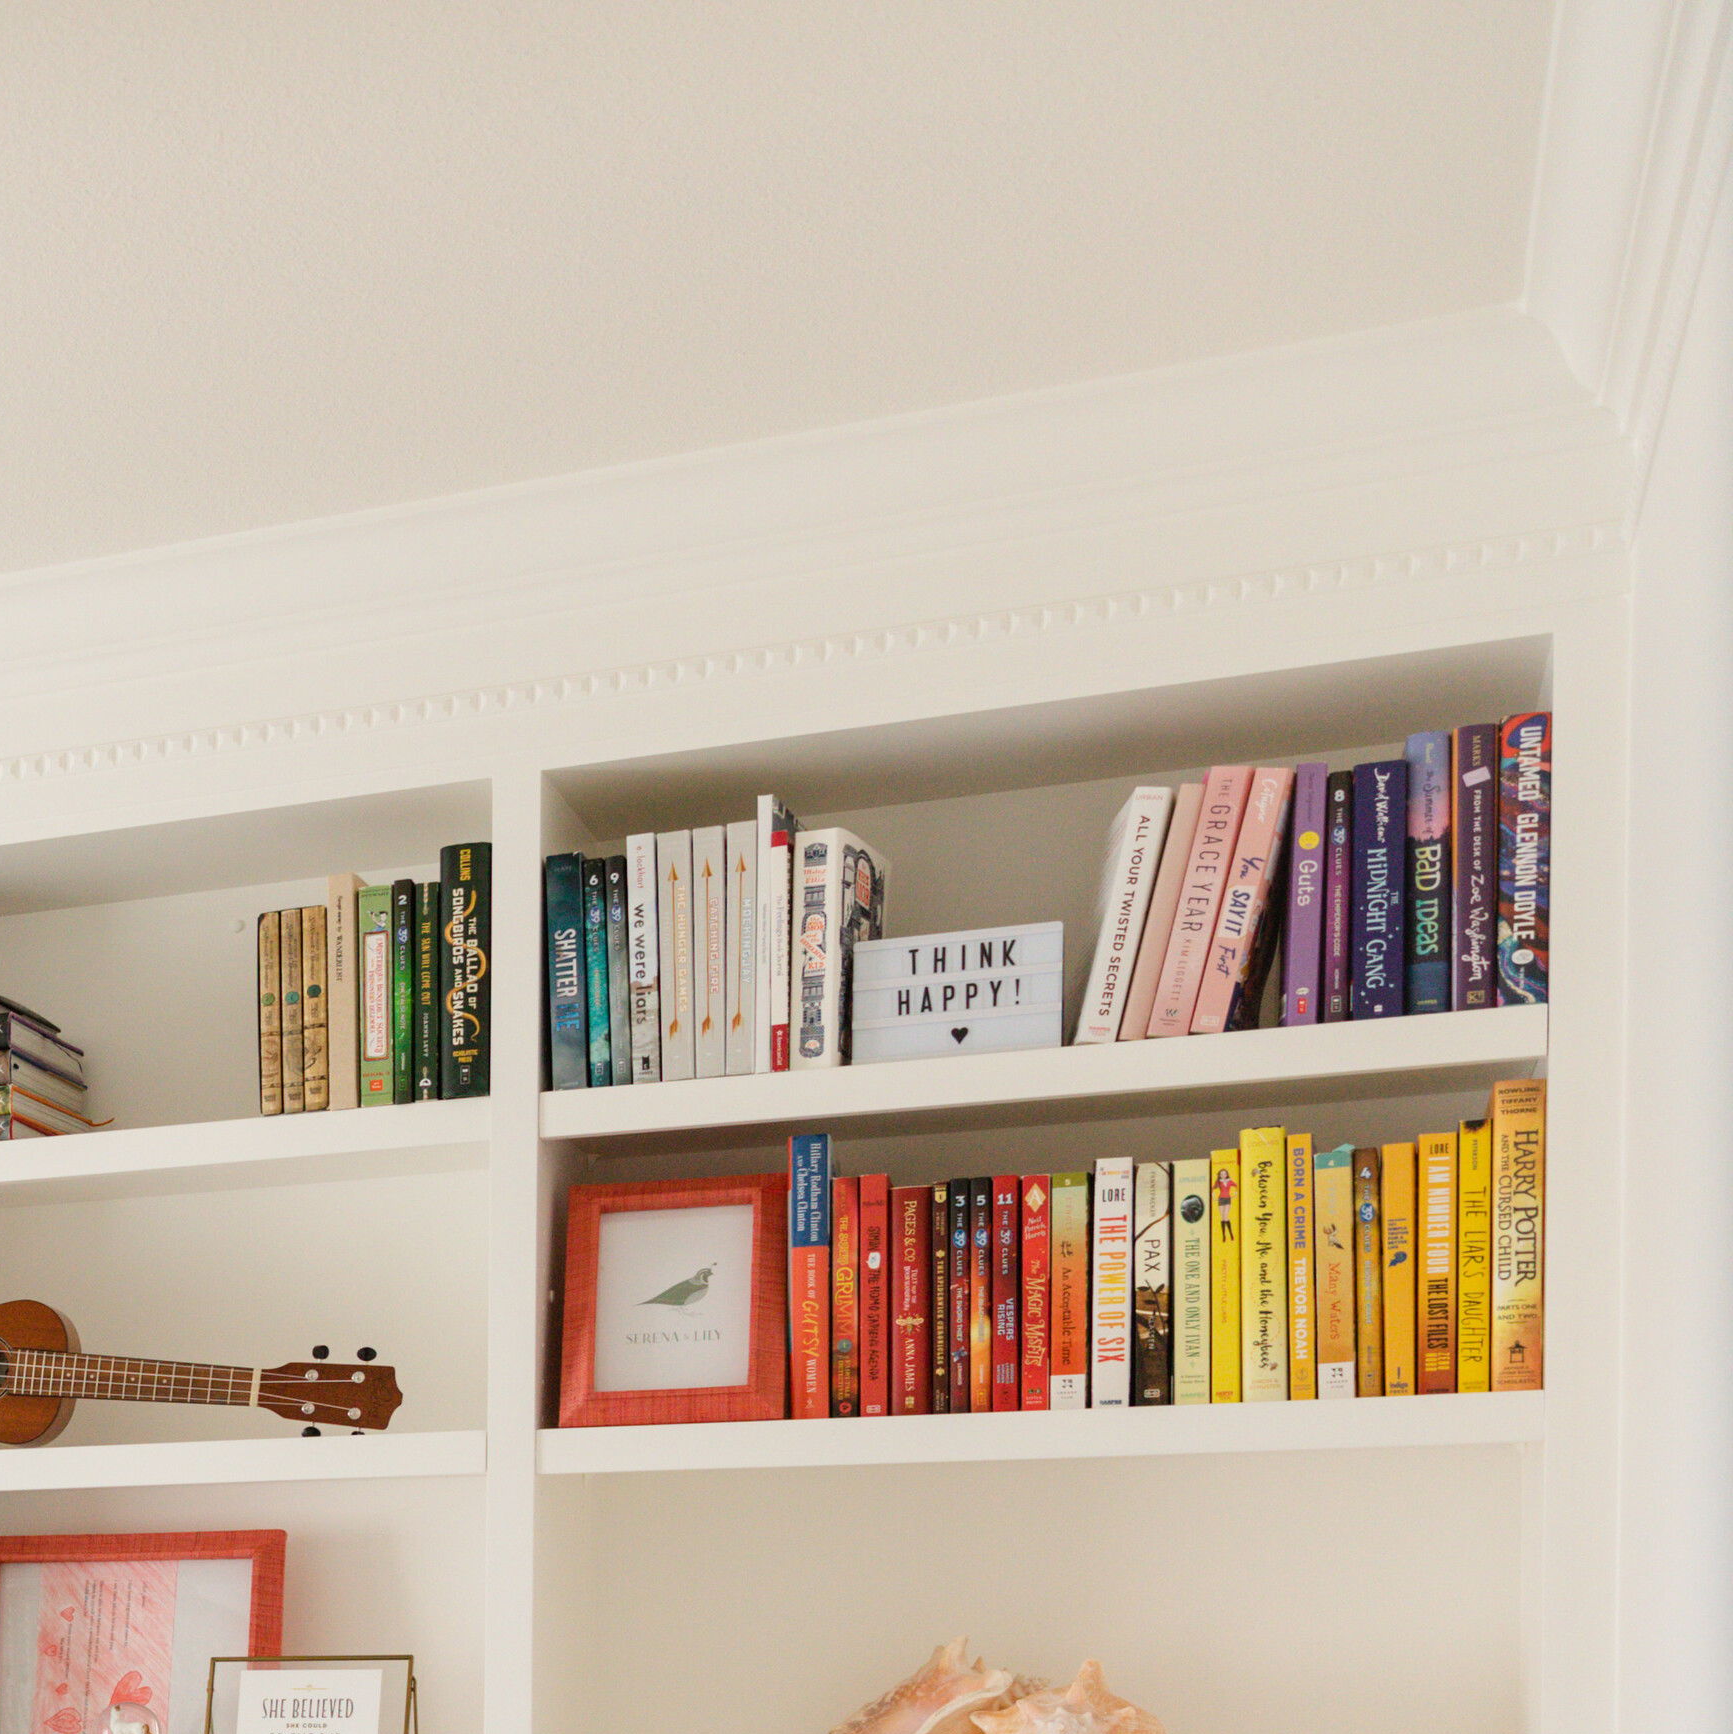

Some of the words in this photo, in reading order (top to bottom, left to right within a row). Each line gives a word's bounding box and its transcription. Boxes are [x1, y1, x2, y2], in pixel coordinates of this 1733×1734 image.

[1517, 726, 1542, 801] UNTAMED
[1218, 779, 1233, 797] THE
[1473, 790, 1482, 813] FROM
[1135, 815, 1151, 842] ALL
[1195, 804, 1231, 874] GRACE
[1473, 817, 1481, 832] THE
[1473, 836, 1481, 858] DESK
[1514, 813, 1539, 886] GLENNON
[459, 849, 472, 881] COLLINS
[1126, 847, 1145, 885] YOUR
[1473, 861, 1481, 871] OF
[1297, 859, 1318, 907] Guts
[398, 895, 408, 905] 2
[634, 903, 646, 929] we
[1180, 882, 1213, 932] YEAR
[1229, 890, 1251, 918] SAY
[1513, 891, 1535, 940] DOYLE
[452, 887, 464, 965] SONGBIRDS
[468, 918, 477, 936] THE
[1113, 890, 1136, 951] TWISTED
[1224, 918, 1243, 936] IT
[635, 934, 648, 979] were
[909, 939, 1016, 975] THINK
[1461, 907, 1490, 981] Washington
[466, 939, 478, 994] BALLAD
[554, 928, 578, 998] SHATTER
[1365, 939, 1387, 989] GANG
[898, 978, 1020, 1016] HAPPY!
[1099, 956, 1121, 1016] SECRETS
[452, 991, 464, 1046] SNAKES
[468, 997, 477, 1010] OF
[635, 986, 653, 1025] liars
[807, 1142, 822, 1174] Hillary
[1293, 1147, 1306, 1187] BORN
[1513, 1128, 1539, 1198] HARRY
[1427, 1166, 1450, 1183] AM
[810, 1176, 822, 1210] Rodham
[954, 1195, 965, 1207] 3
[976, 1194, 986, 1206] 5
[997, 1194, 1013, 1206] 11
[1102, 1188, 1126, 1202] LORE
[1293, 1192, 1306, 1201] A
[1464, 1186, 1487, 1218] THE
[1497, 1174, 1513, 1231] CURSED
[810, 1211, 822, 1242] Clinton
[1098, 1214, 1128, 1244] THE
[1294, 1206, 1307, 1250] CRIME
[1427, 1188, 1450, 1238] NUMBER
[807, 1253, 816, 1268] THE
[1144, 1239, 1161, 1273] PAX
[1185, 1237, 1200, 1257] THE
[1426, 1242, 1450, 1273] FOUR
[1462, 1231, 1487, 1279] LIAR'S
[1497, 1236, 1512, 1280] CHILD
[1513, 1204, 1539, 1287] POTTER
[807, 1270, 816, 1288] BOOK
[1098, 1252, 1127, 1306] POWER
[1185, 1260, 1200, 1280] ONE
[1293, 1257, 1307, 1313] TREVOR
[1324, 1262, 1341, 1294] Many
[807, 1289, 816, 1298] OF
[1185, 1283, 1200, 1304] AND
[1427, 1278, 1449, 1296] THE
[997, 1303, 1005, 1336] RISING
[1005, 1298, 1014, 1340] VESPERS
[1059, 1285, 1076, 1336] Acceptable
[1098, 1310, 1126, 1329] OF
[1185, 1306, 1200, 1331] ONLY
[1329, 1300, 1342, 1340] Waters
[1426, 1297, 1449, 1321] LOST
[800, 1300, 821, 1357] GUTSY
[1295, 1317, 1308, 1360] NOAH
[1426, 1324, 1449, 1349] FILES
[1461, 1292, 1484, 1363] DAUGHTER
[904, 1338, 916, 1360] ANNA
[1062, 1340, 1072, 1365] Time
[1097, 1337, 1125, 1363] SIX
[1185, 1333, 1200, 1358] IVAN
[805, 1358, 816, 1393] WOMEN
[904, 1362, 916, 1392] JAMES
[261, 1698, 287, 1719] SHE
[292, 1698, 354, 1719] BELIEVED
